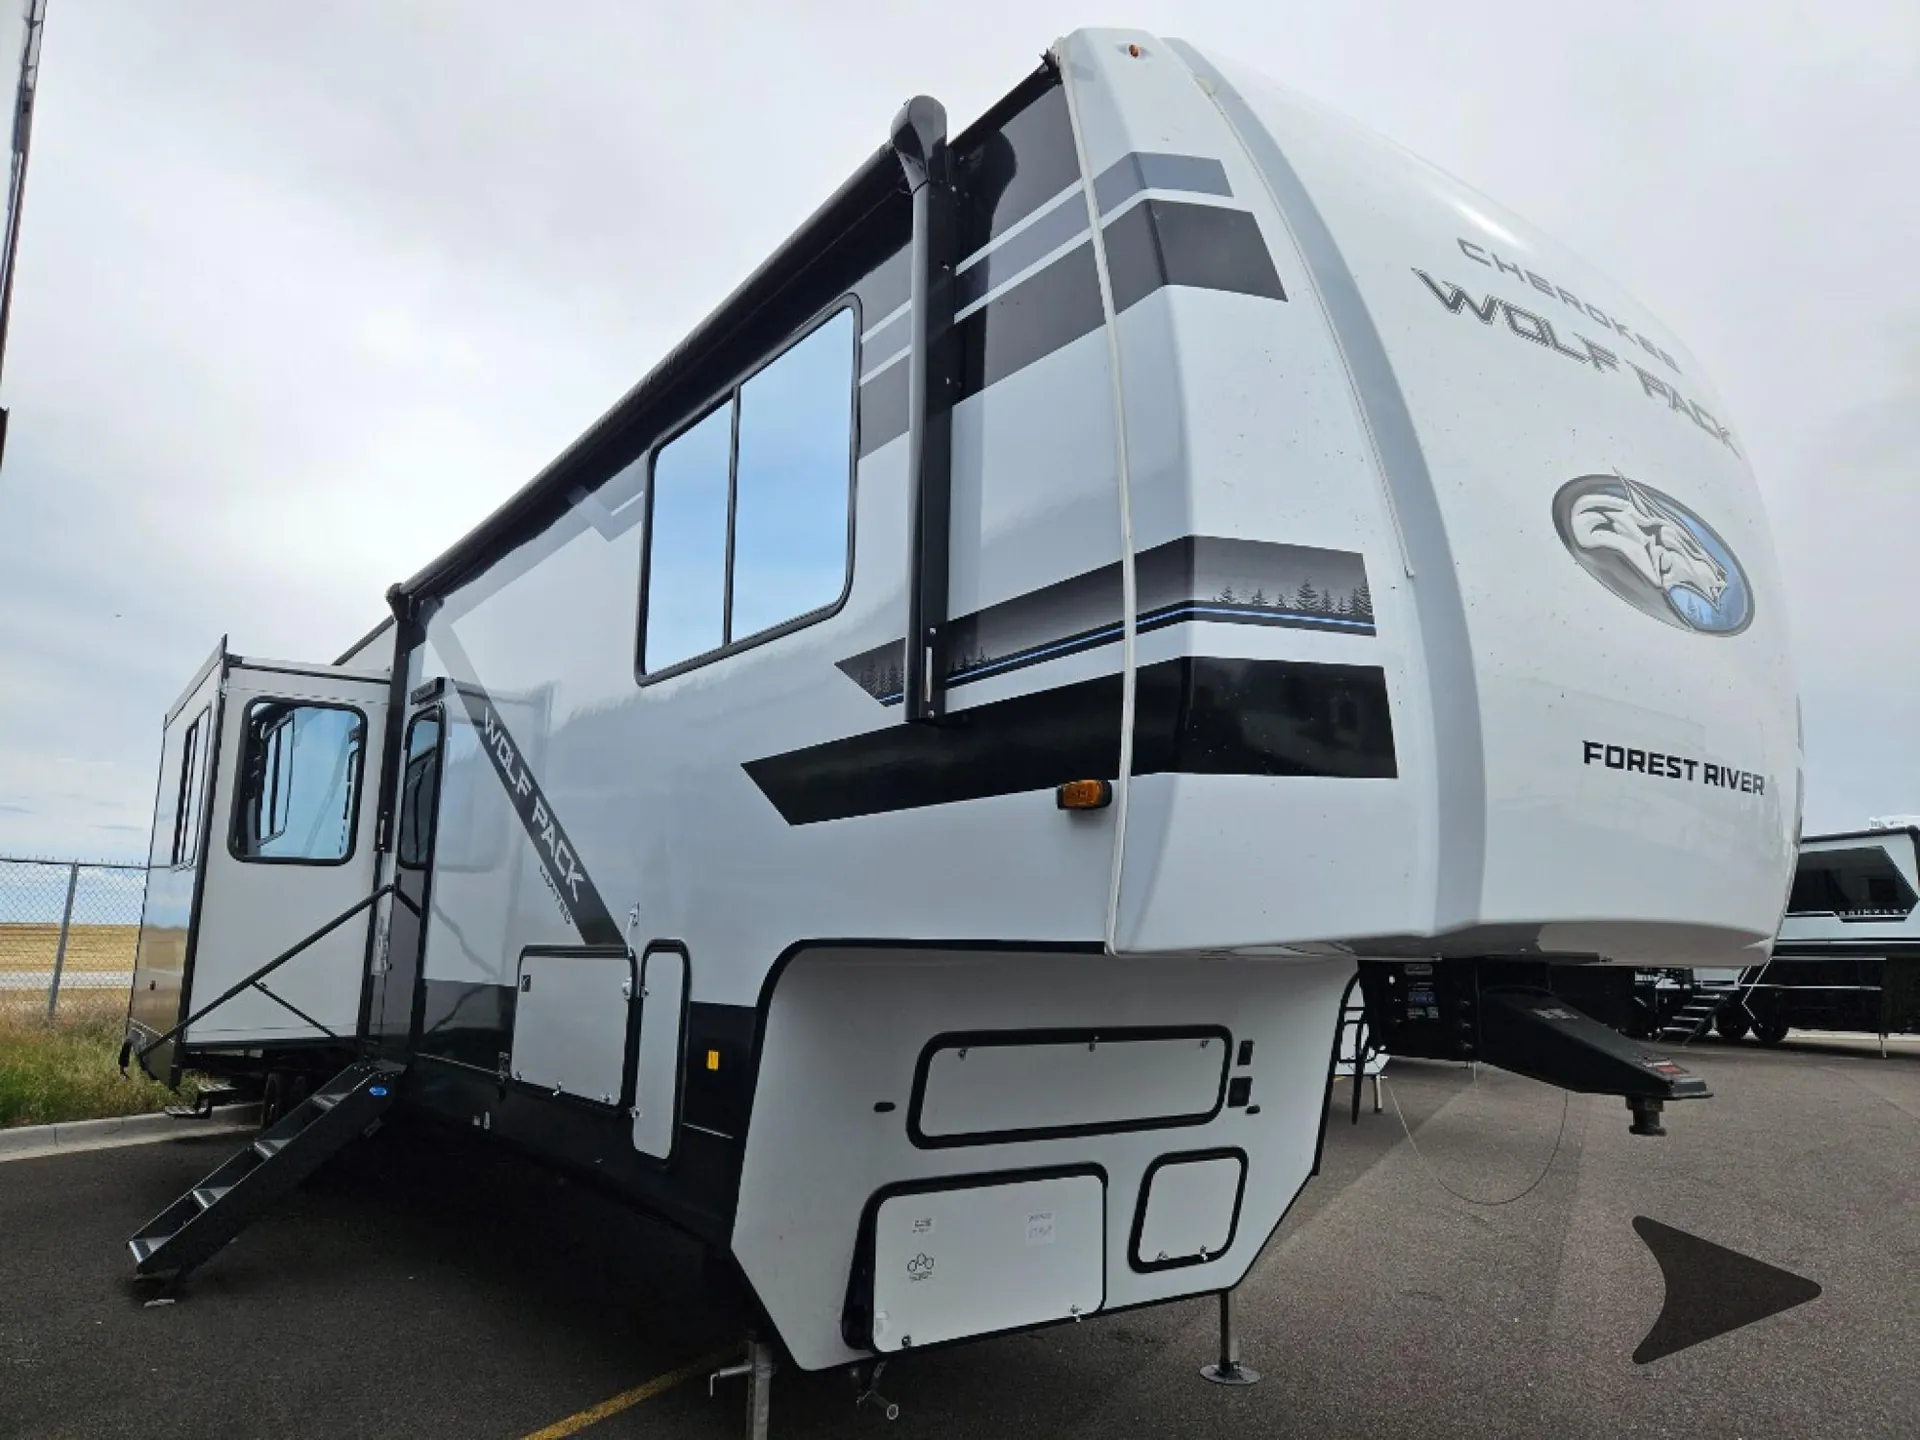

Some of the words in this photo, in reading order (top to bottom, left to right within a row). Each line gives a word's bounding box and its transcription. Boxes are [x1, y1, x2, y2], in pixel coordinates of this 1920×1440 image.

[1411, 266, 1620, 373] WOLF
[1624, 357, 1742, 460] PACK
[1456, 237, 1682, 375] CHEROKEE
[484, 706, 532, 797] WOLF
[531, 796, 585, 902] PACK
[1582, 740, 1699, 781] FOREST
[1703, 762, 1766, 796] RIVER
